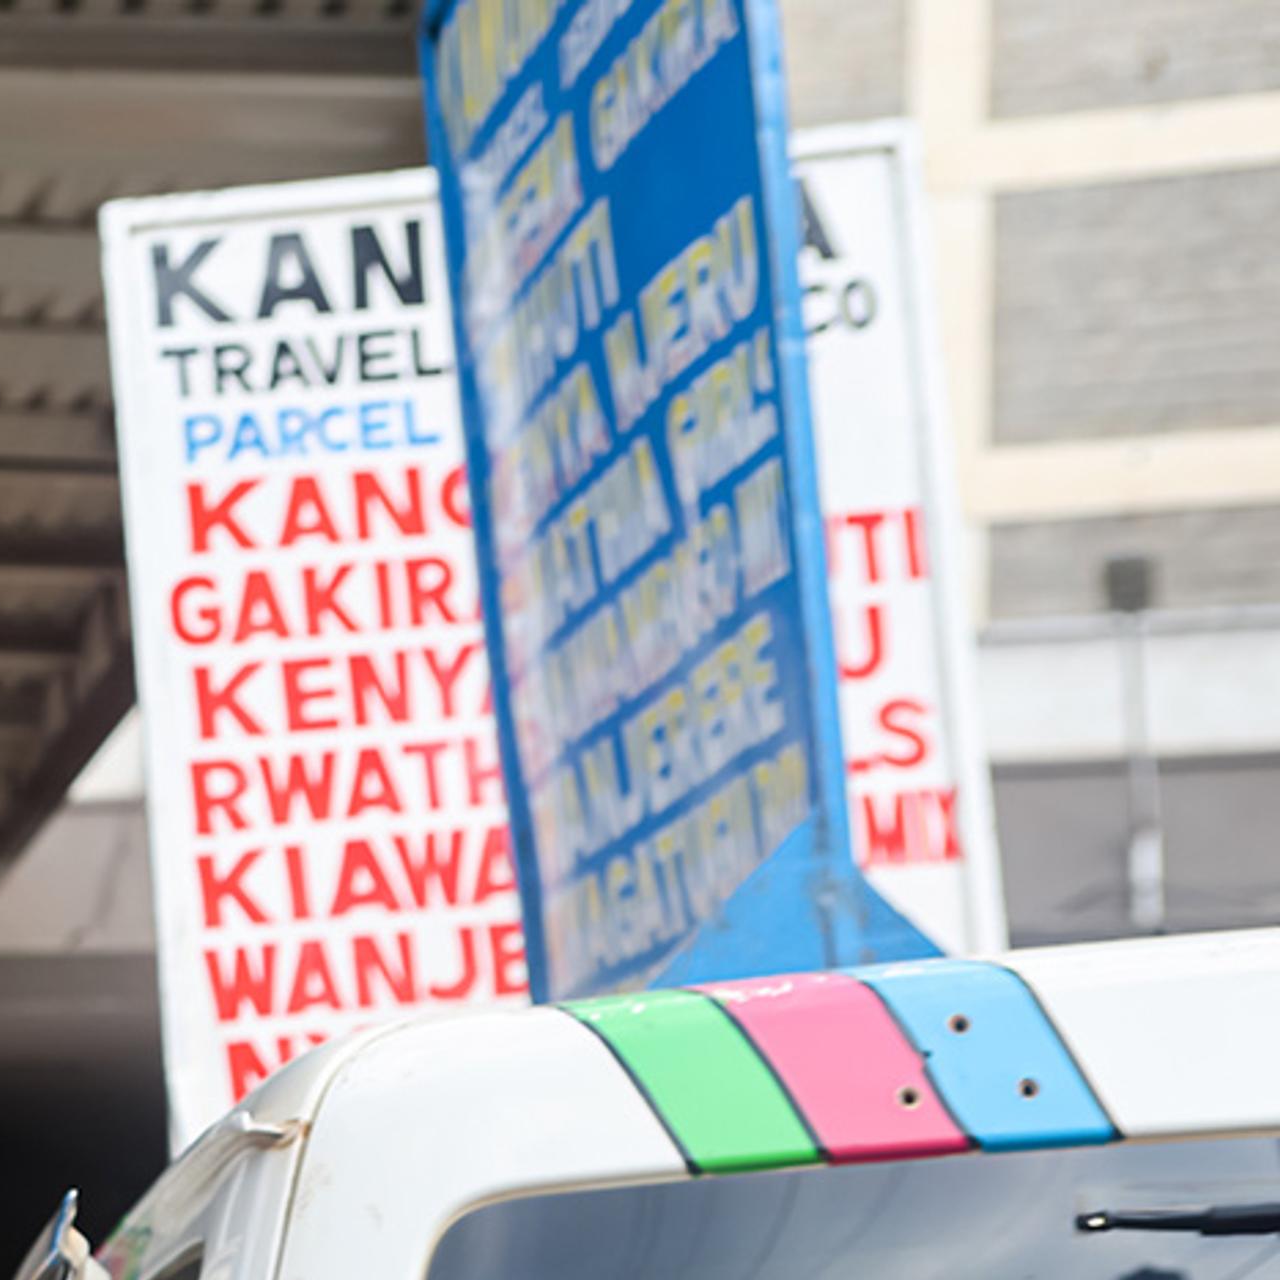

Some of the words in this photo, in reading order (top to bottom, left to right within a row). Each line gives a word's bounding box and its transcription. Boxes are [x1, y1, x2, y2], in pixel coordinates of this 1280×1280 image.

[183, 396, 443, 465] PARCEL
[170, 556, 483, 646] GAKIR
[193, 645, 494, 741] KENY
